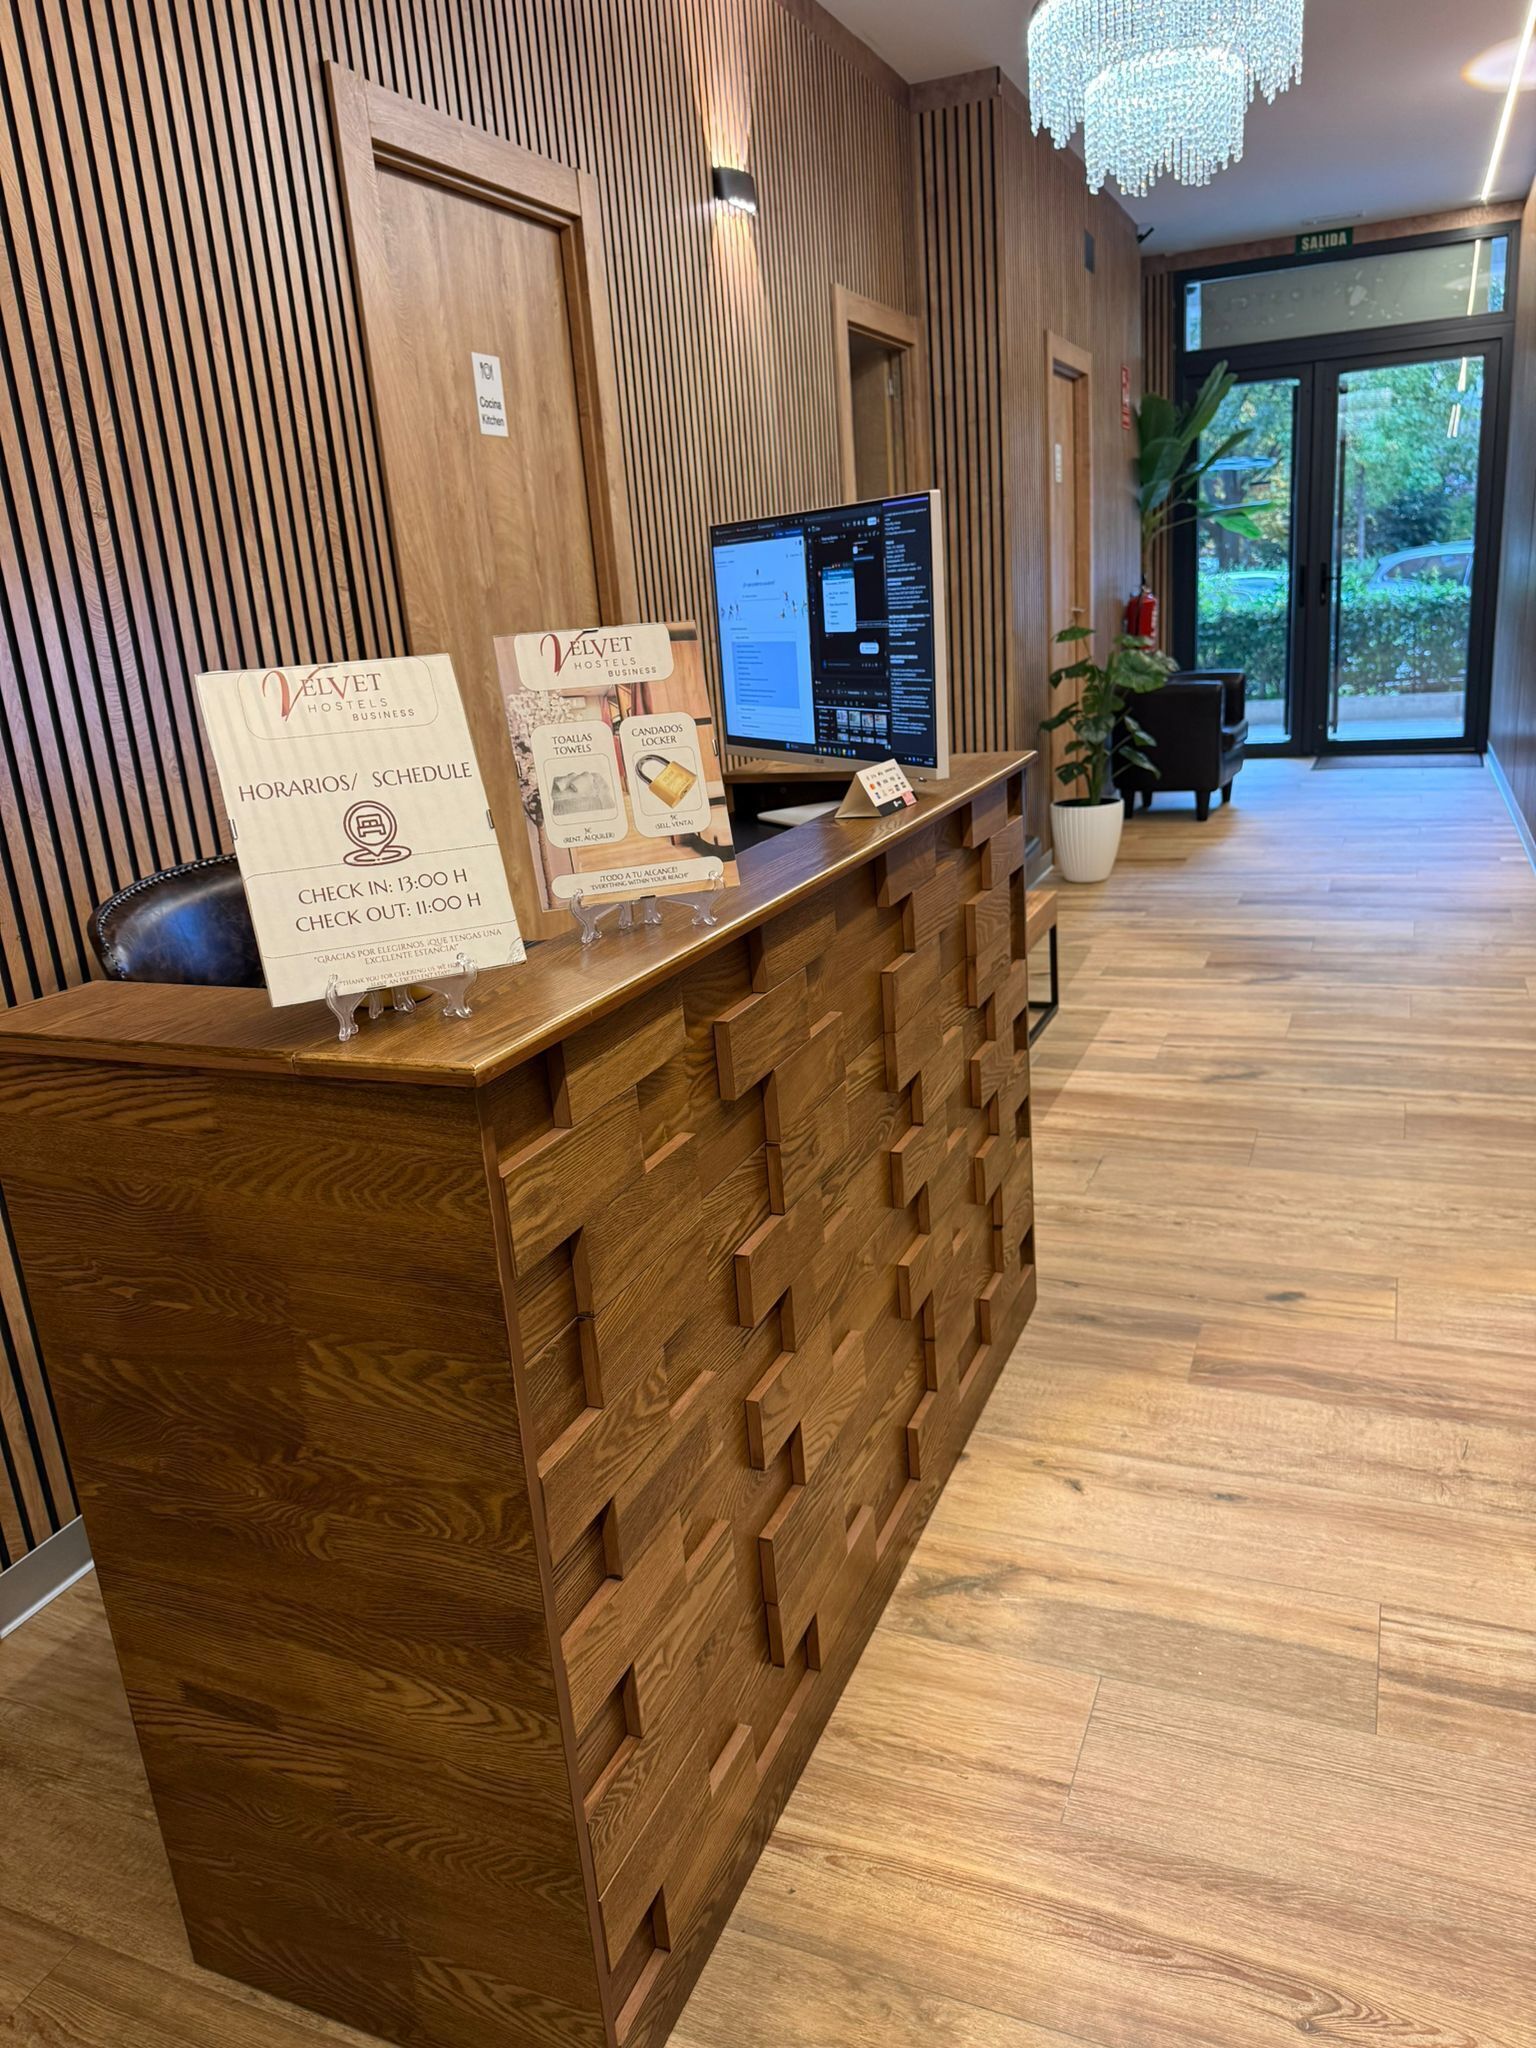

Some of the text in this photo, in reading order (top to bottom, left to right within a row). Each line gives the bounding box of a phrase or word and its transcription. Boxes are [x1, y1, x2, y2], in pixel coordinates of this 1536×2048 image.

[1301, 231, 1347, 251] SALIDA
[479, 396, 503, 410] Cocina
[481, 413, 505, 427] Kitchen
[540, 630, 632, 677] VELVET
[574, 656, 636, 670] HOSTELS
[608, 666, 657, 677] BUSINESS
[262, 665, 382, 722] VELVET
[308, 697, 388, 713] HOSTELS
[352, 708, 415, 721] BUSINESS
[631, 723, 684, 737] CANDADOS
[551, 732, 593, 745] TOALLAS
[641, 735, 677, 747] LOCKER
[552, 744, 592, 756] TOWELS
[238, 762, 473, 802] HORARIOS/ SCHEDULE
[600, 866, 679, 883] ¡TODO A TU ALCANCE!
[298, 868, 468, 905] CHECK IN: 13:00 H
[296, 892, 481, 933] CHECK OUT: 11:00 H
[314, 950, 356, 964] "GRACIAS
[357, 948, 376, 958] POR
[449, 930, 482, 943] TENGAS
[483, 928, 502, 938] UNA
[365, 949, 413, 965] EXCELENTE
